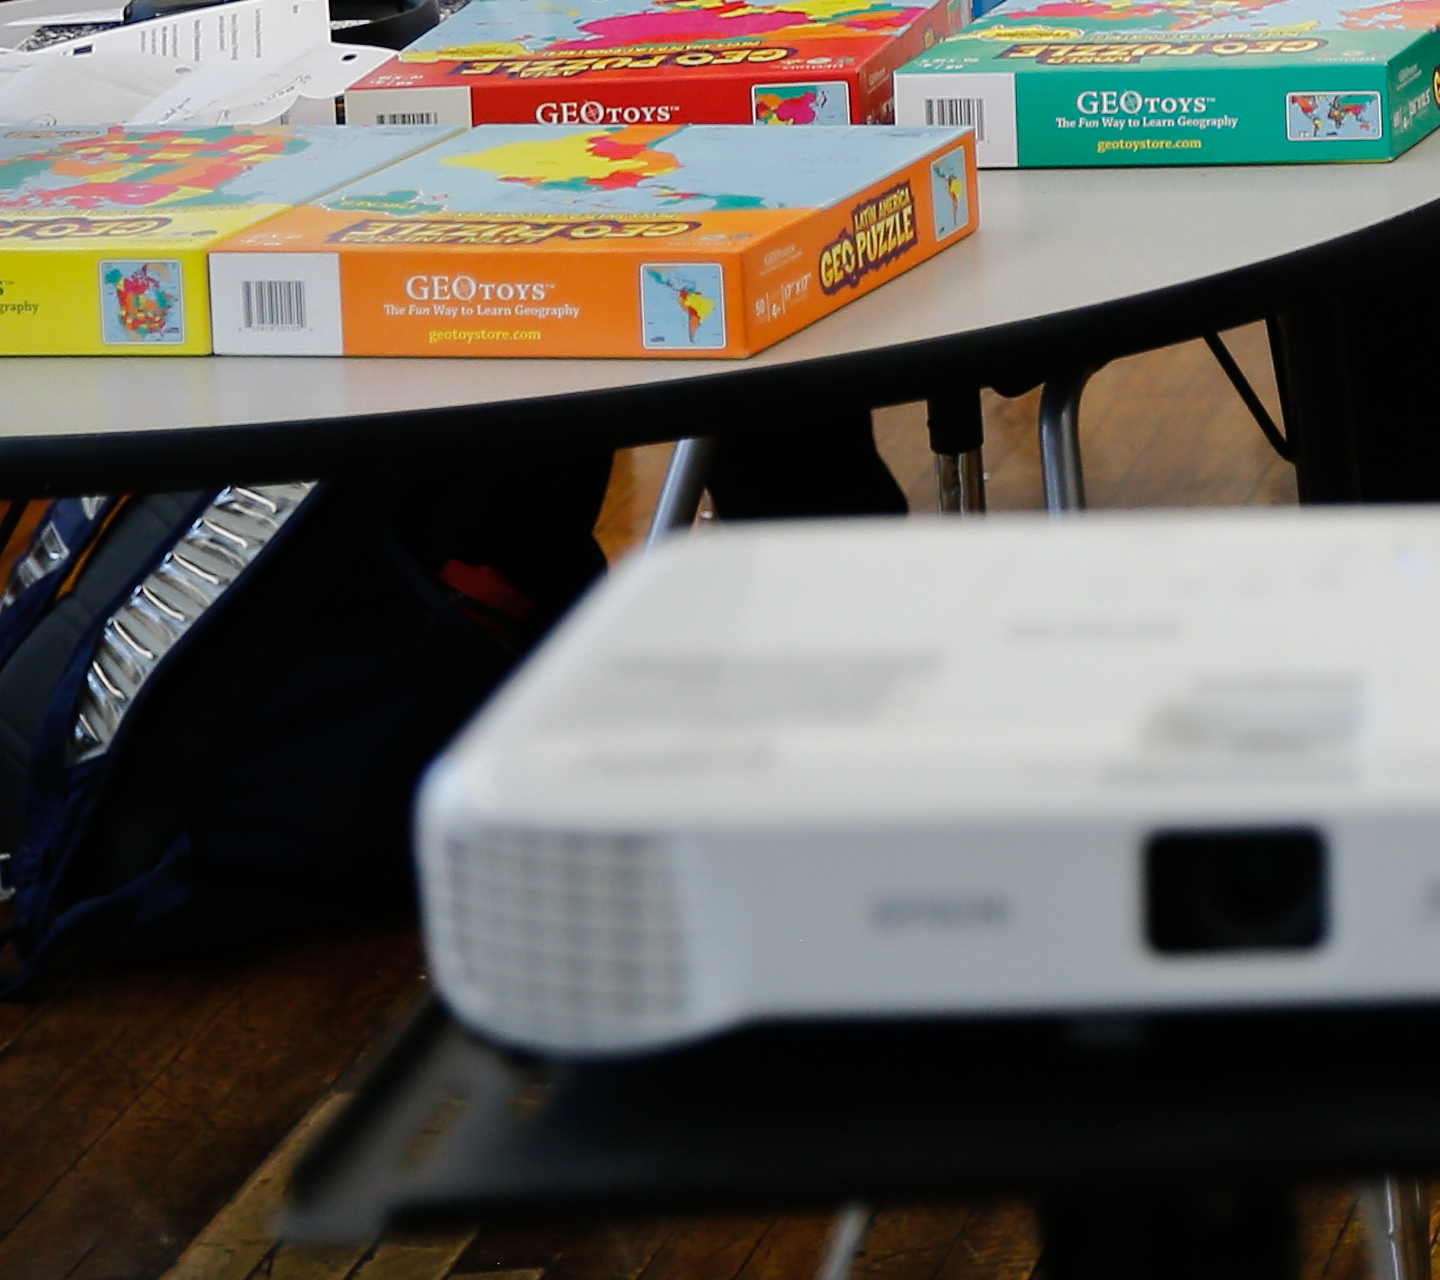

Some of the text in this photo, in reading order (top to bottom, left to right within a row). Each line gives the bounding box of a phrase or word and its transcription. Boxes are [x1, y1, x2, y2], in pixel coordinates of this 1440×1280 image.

[1055, 116, 1239, 131] The Fun Way to Learn Geography
[1096, 138, 1202, 154] geotoystore.com
[819, 205, 915, 290] GEO PUZZLE
[384, 304, 581, 320] The Fun Way to Learn Geography
[428, 328, 542, 344] geotoystore.com
